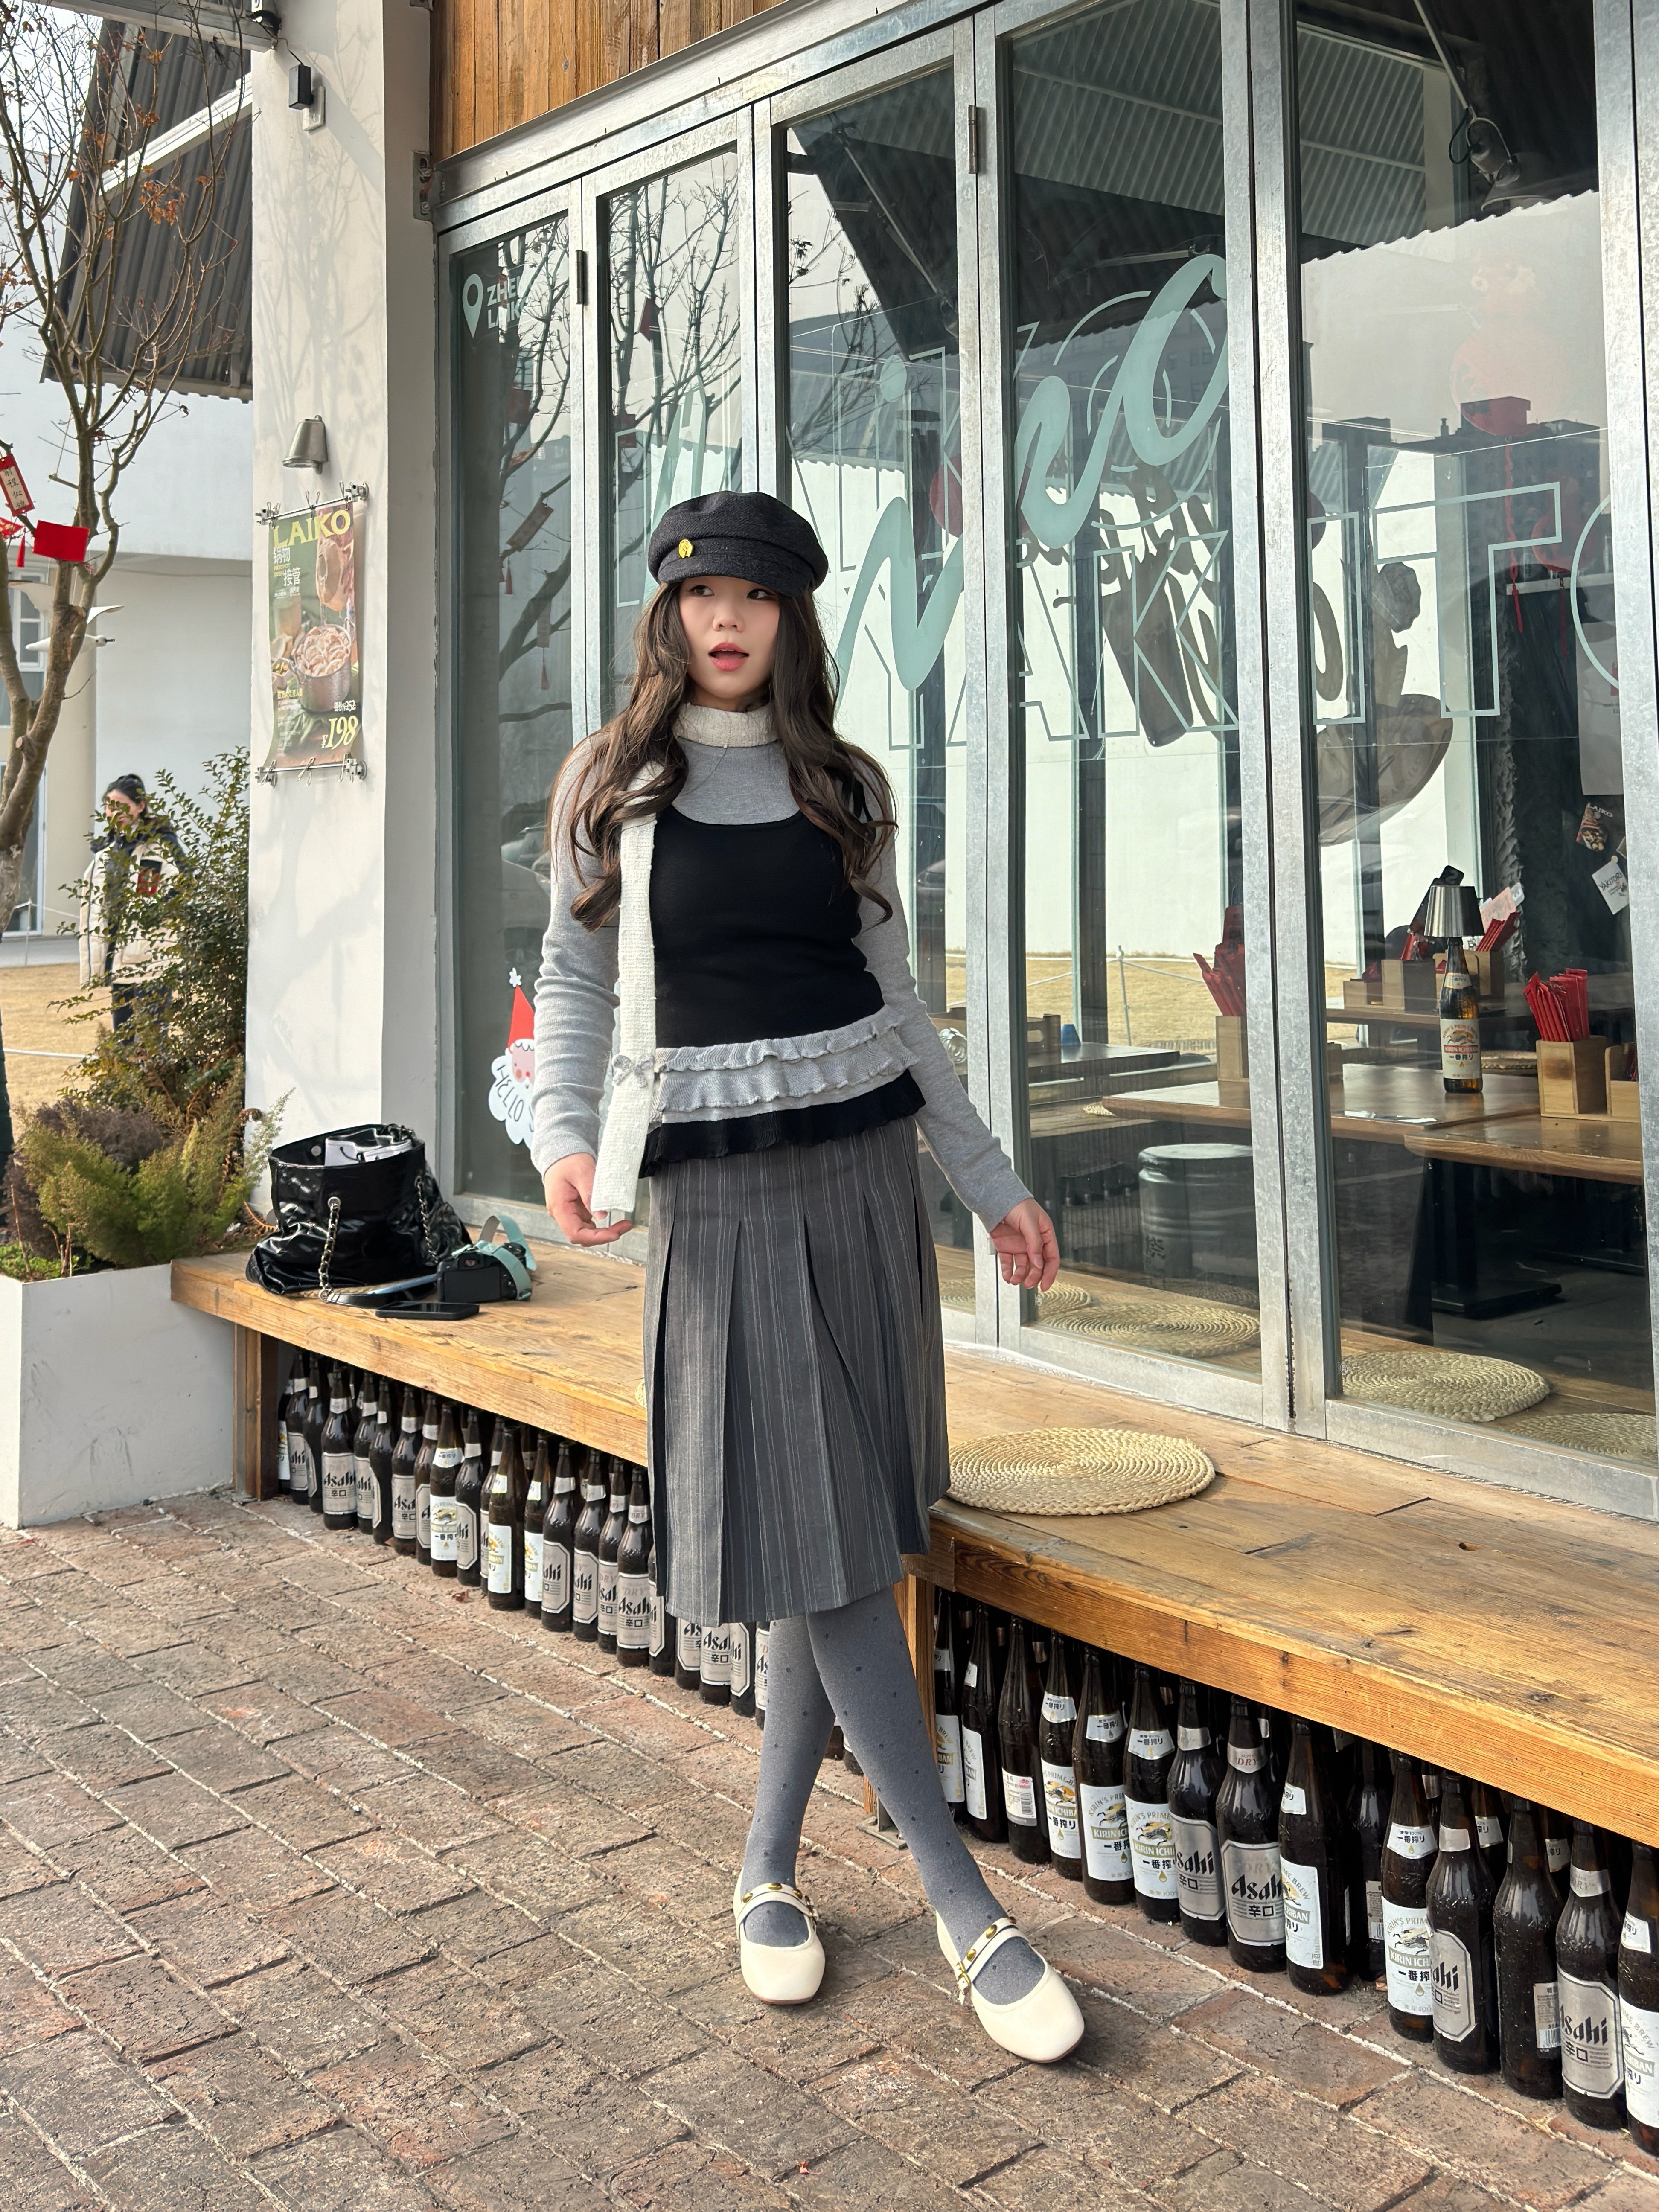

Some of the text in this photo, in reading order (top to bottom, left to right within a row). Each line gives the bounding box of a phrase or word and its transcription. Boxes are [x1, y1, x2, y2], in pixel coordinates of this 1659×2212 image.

[488, 301, 522, 329] LIK
[273, 509, 351, 548] LAIKO
[284, 567, 300, 586] 接管
[291, 1450, 305, 1465] ahi
[357, 1476, 371, 1491] ahi
[394, 1495, 416, 1510] Asa
[544, 1563, 561, 1581] ahi
[576, 1573, 592, 1591] ahi
[619, 1597, 650, 1615] Asah
[626, 1619, 643, 1627] 辛口
[704, 1631, 730, 1650] Asa
[711, 1654, 728, 1663] 辛口
[1045, 1702, 1065, 1710] 一番搾り
[1097, 1720, 1118, 1729] 一番搾り
[939, 1727, 953, 1744] BREW
[1137, 1738, 1163, 1746] 一番搾り
[1237, 1758, 1257, 1766] DRY
[1089, 1797, 1109, 1817] KIRIN'S
[1048, 1816, 1076, 1830] 一番搾り
[1094, 1829, 1117, 1838] KIRIN
[1397, 1835, 1425, 1843] 一番搾り
[1104, 1839, 1129, 1851] 一番搾
[1134, 1842, 1173, 1856] KIRIN ICHI
[1174, 1850, 1214, 1875] sahi
[1179, 1873, 1198, 1891] 辛口
[1231, 1874, 1281, 1901] Asah
[1292, 1877, 1311, 1900] BREW
[1248, 1904, 1274, 1917] 辛口
[1285, 1903, 1308, 1922] CHIBAN
[1387, 1918, 1404, 1936] KIRIN'S
[1390, 1950, 1412, 1966] KIRIN
[1398, 1970, 1429, 1981] 一番搾
[1432, 1961, 1458, 1991] ahi
[1635, 2023, 1655, 2049] BREW
[1566, 2041, 1588, 2063] 辛口
